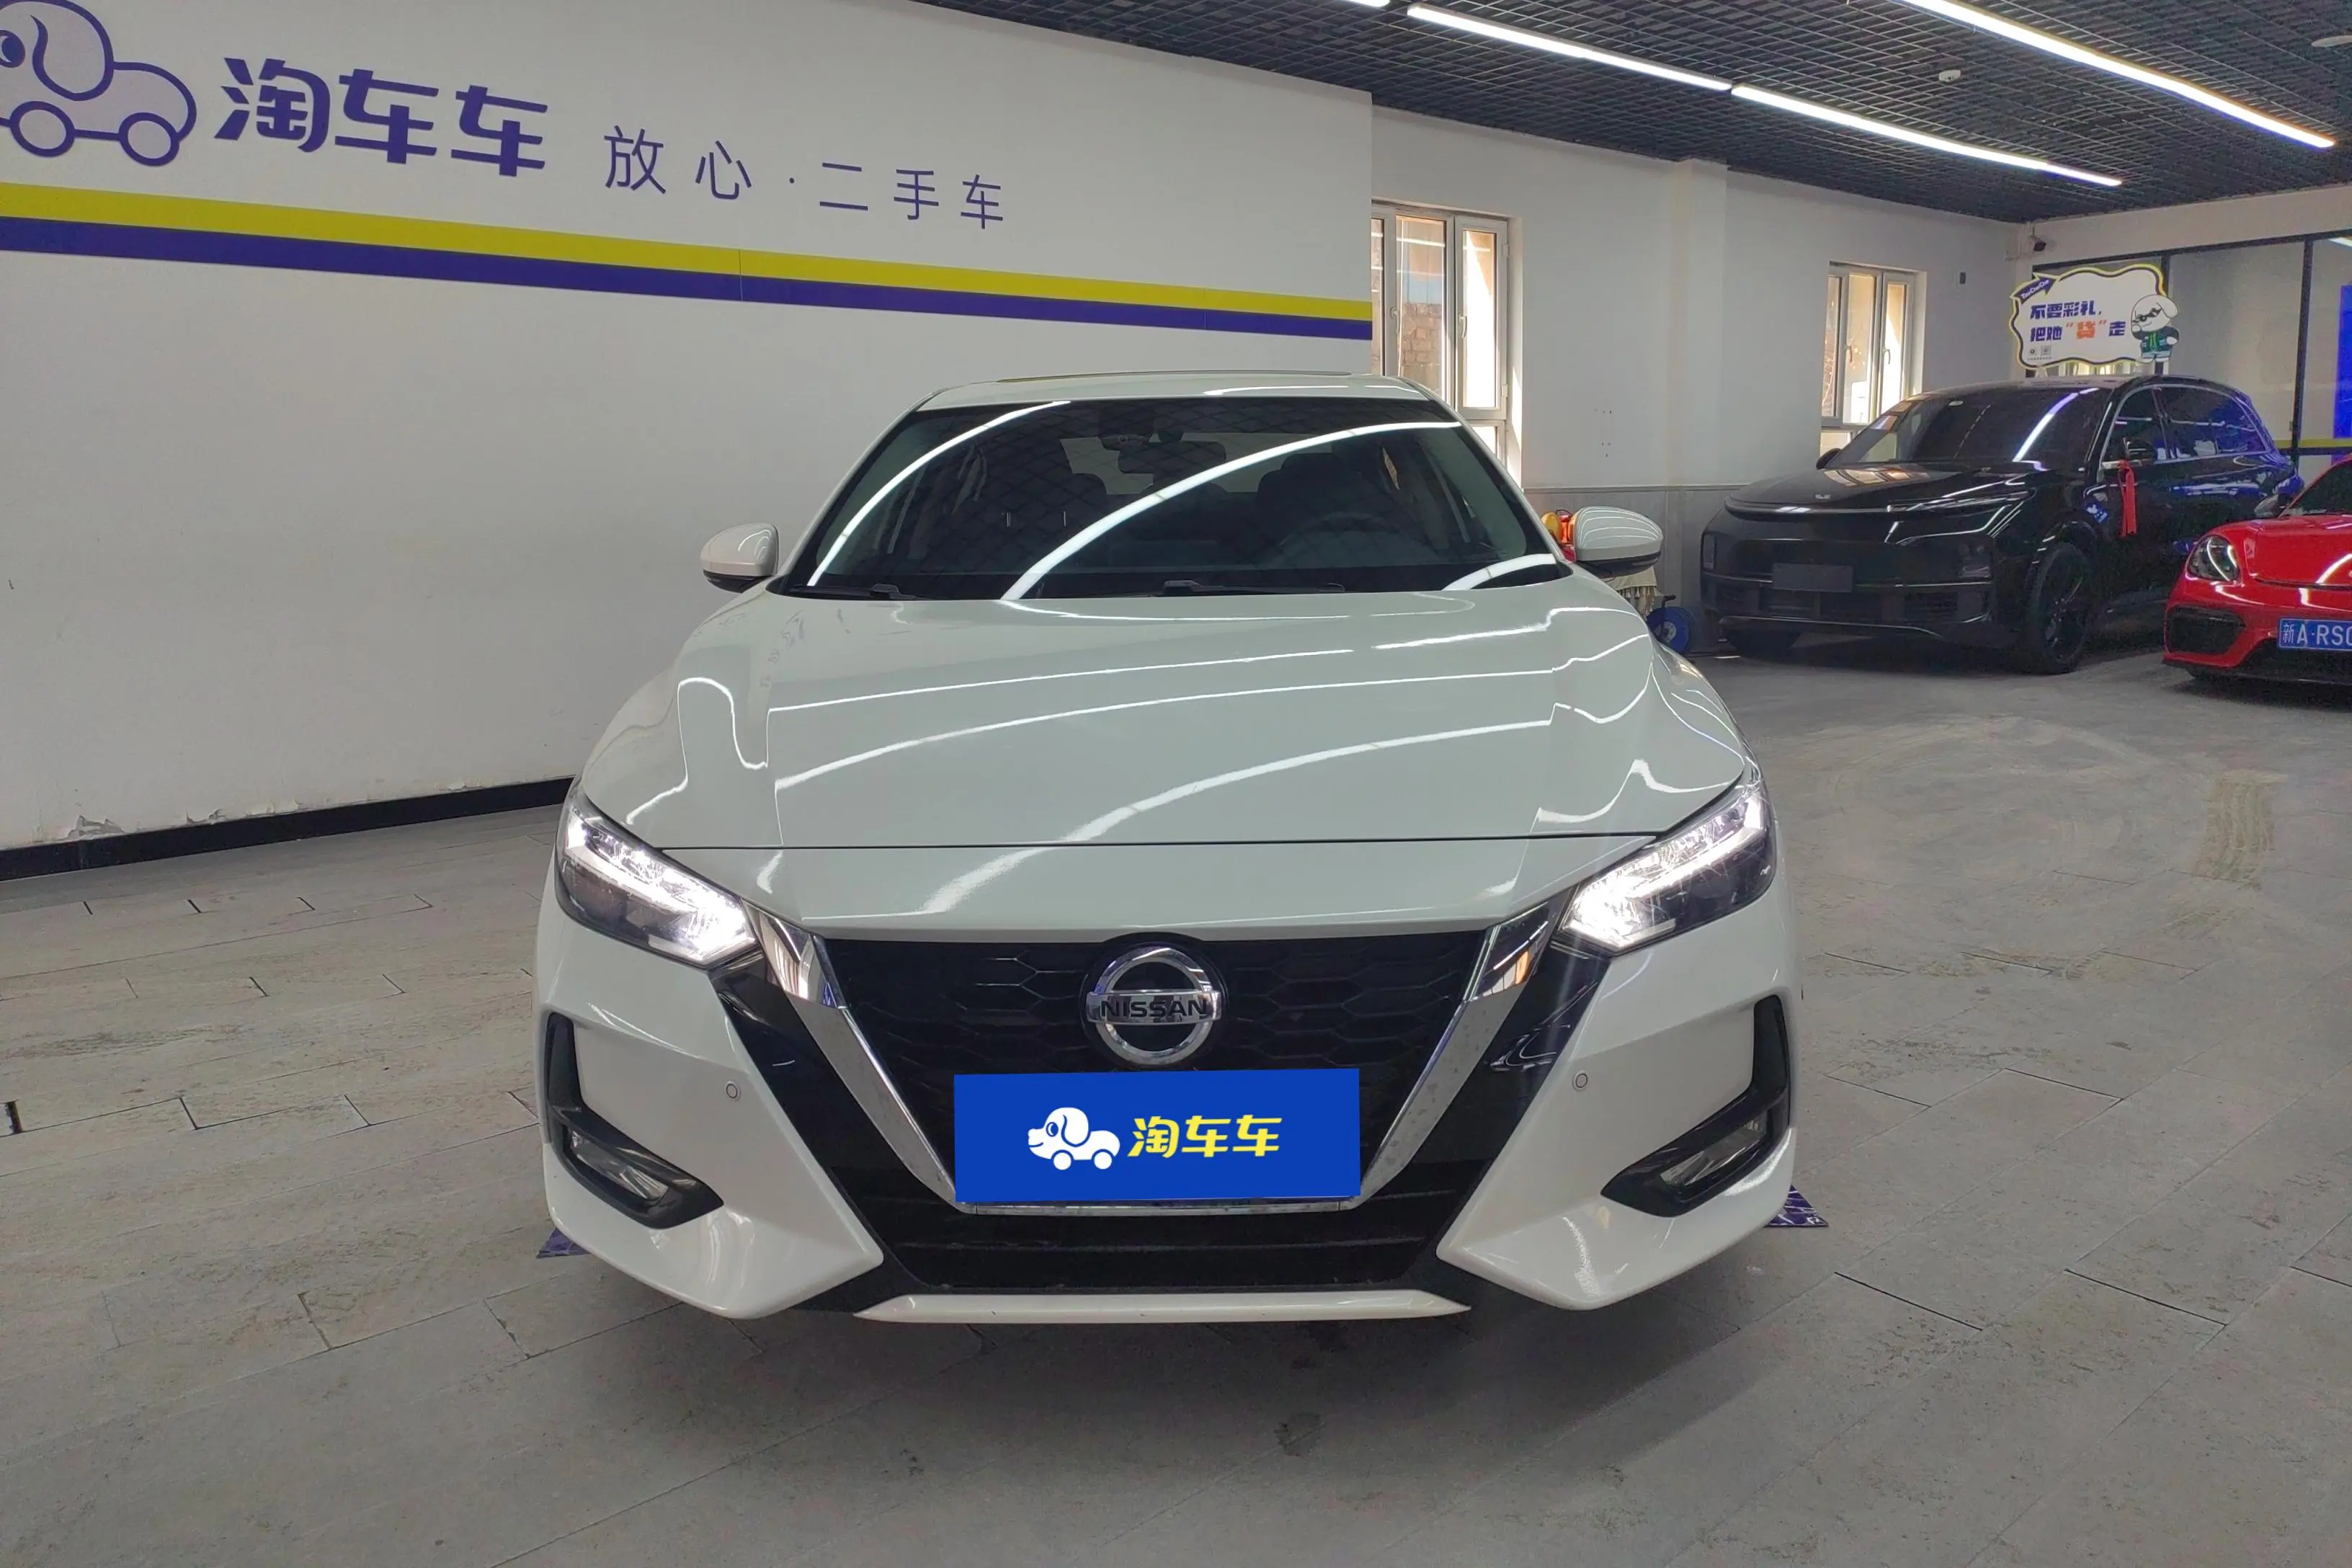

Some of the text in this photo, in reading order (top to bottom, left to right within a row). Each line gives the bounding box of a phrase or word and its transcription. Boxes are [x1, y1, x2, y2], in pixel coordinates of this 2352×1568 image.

[214, 57, 548, 177] 淘车车
[1100, 999, 1206, 1017] NISSAN
